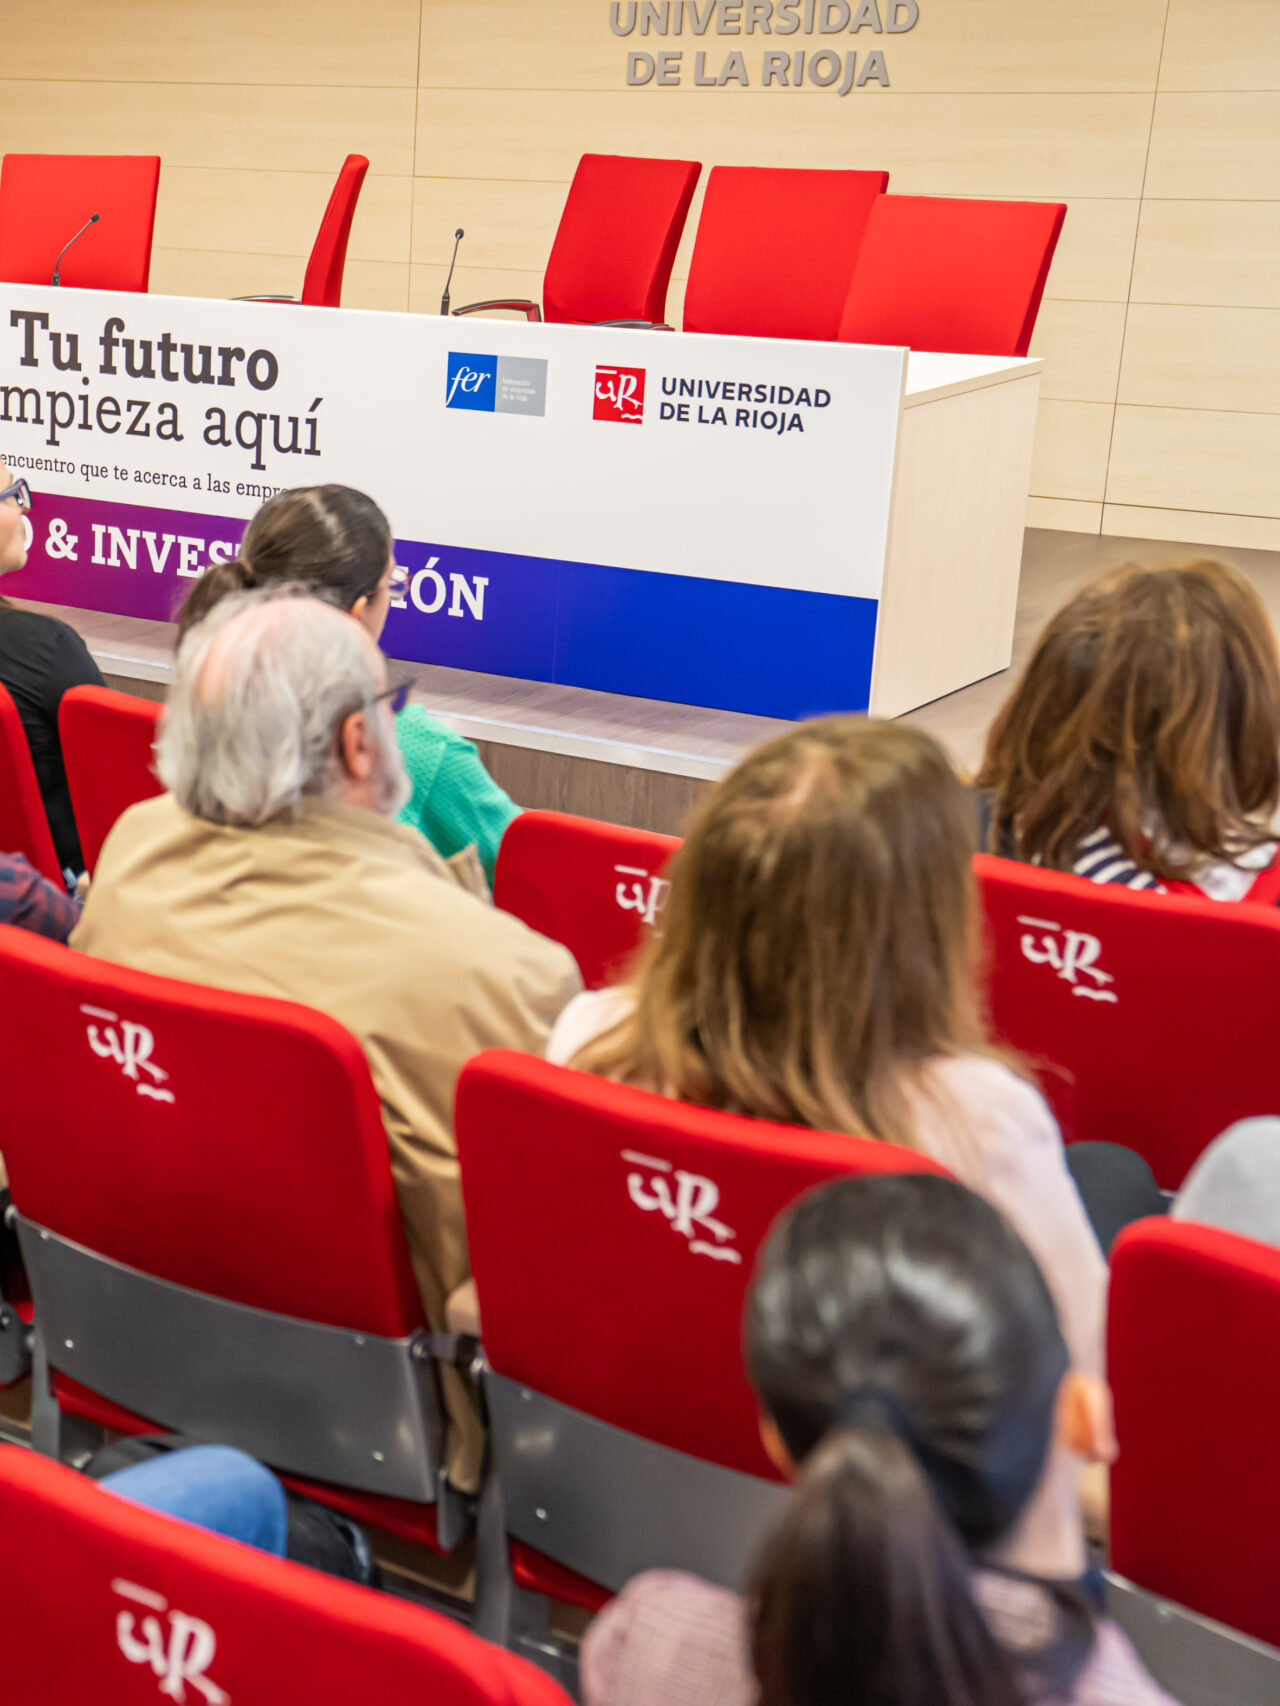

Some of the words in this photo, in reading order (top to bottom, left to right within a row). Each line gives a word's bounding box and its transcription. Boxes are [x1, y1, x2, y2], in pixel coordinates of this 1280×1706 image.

[609, 0, 919, 36] UNIVERSIDAD
[626, 51, 682, 86] DE
[694, 51, 749, 87] LA
[761, 49, 890, 96] RIOJA
[10, 310, 82, 372] Tu
[99, 317, 279, 391] futuro
[445, 366, 491, 407] fer
[662, 377, 832, 408] UNIVERSIDAD
[203, 397, 324, 472] aquí
[660, 402, 690, 422] DE
[698, 406, 728, 426] LA
[735, 409, 805, 436] RIOJA
[0, 453, 76, 474] encuentro
[80, 463, 109, 482] que
[113, 465, 129, 481] te
[134, 468, 187, 488] acerca
[193, 477, 202, 490] a
[207, 473, 231, 494] las
[45, 517, 78, 561] &
